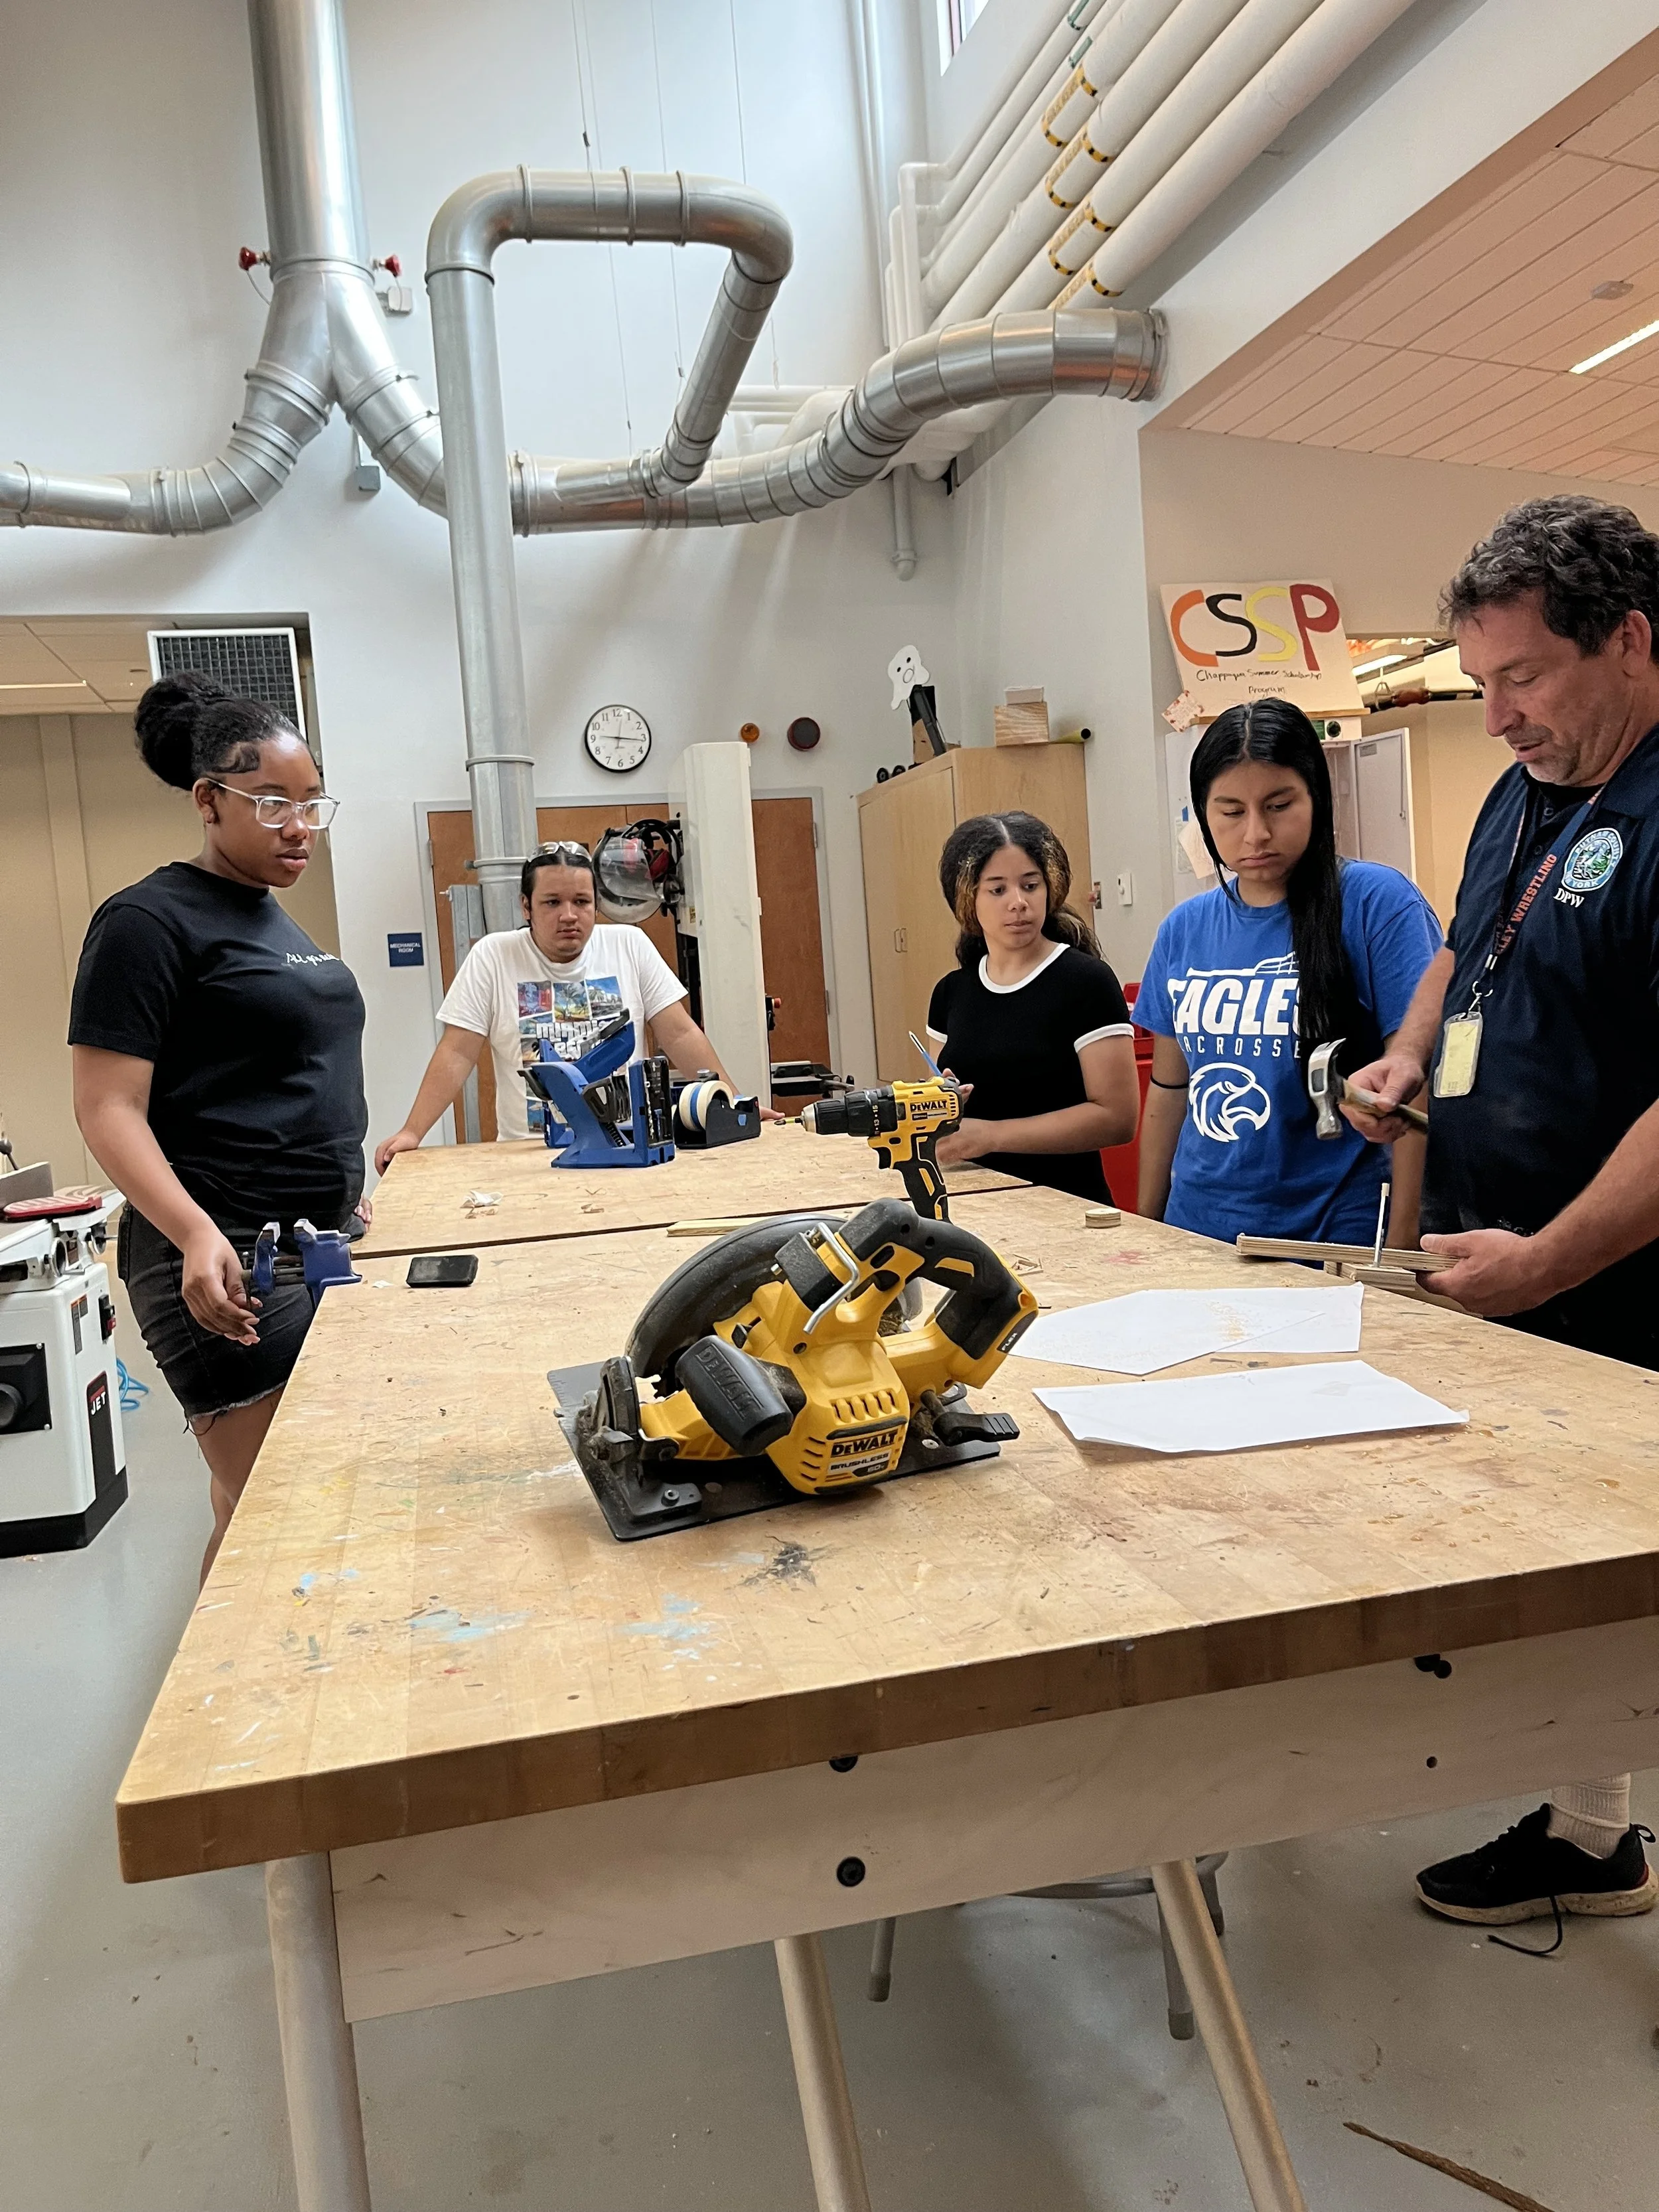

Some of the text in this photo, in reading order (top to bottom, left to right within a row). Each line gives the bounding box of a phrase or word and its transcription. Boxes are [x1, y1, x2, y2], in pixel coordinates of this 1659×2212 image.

[1170, 583, 1340, 672] CSSP
[601, 712, 609, 721] 11
[612, 708, 622, 717] 12
[627, 712, 631, 721] 1
[591, 722, 601, 731] 10
[636, 721, 642, 730] 2
[590, 734, 596, 743] 9
[641, 733, 646, 742] 3
[595, 746, 601, 755] 8
[638, 745, 644, 755] 4
[605, 756, 611, 765] 7
[617, 759, 624, 767] 6
[629, 755, 635, 765] 5
[1553, 887, 1585, 908] DPW
[1167, 978, 1299, 1036] EAGLE
[1180, 1035, 1301, 1059] ACROSSE
[872, 1105, 879, 1114] 15
[1001, 1333, 1018, 1351] FLEX
[91, 1392, 106, 1415] JET
[830, 1453, 889, 1470] BRUSHLESS
